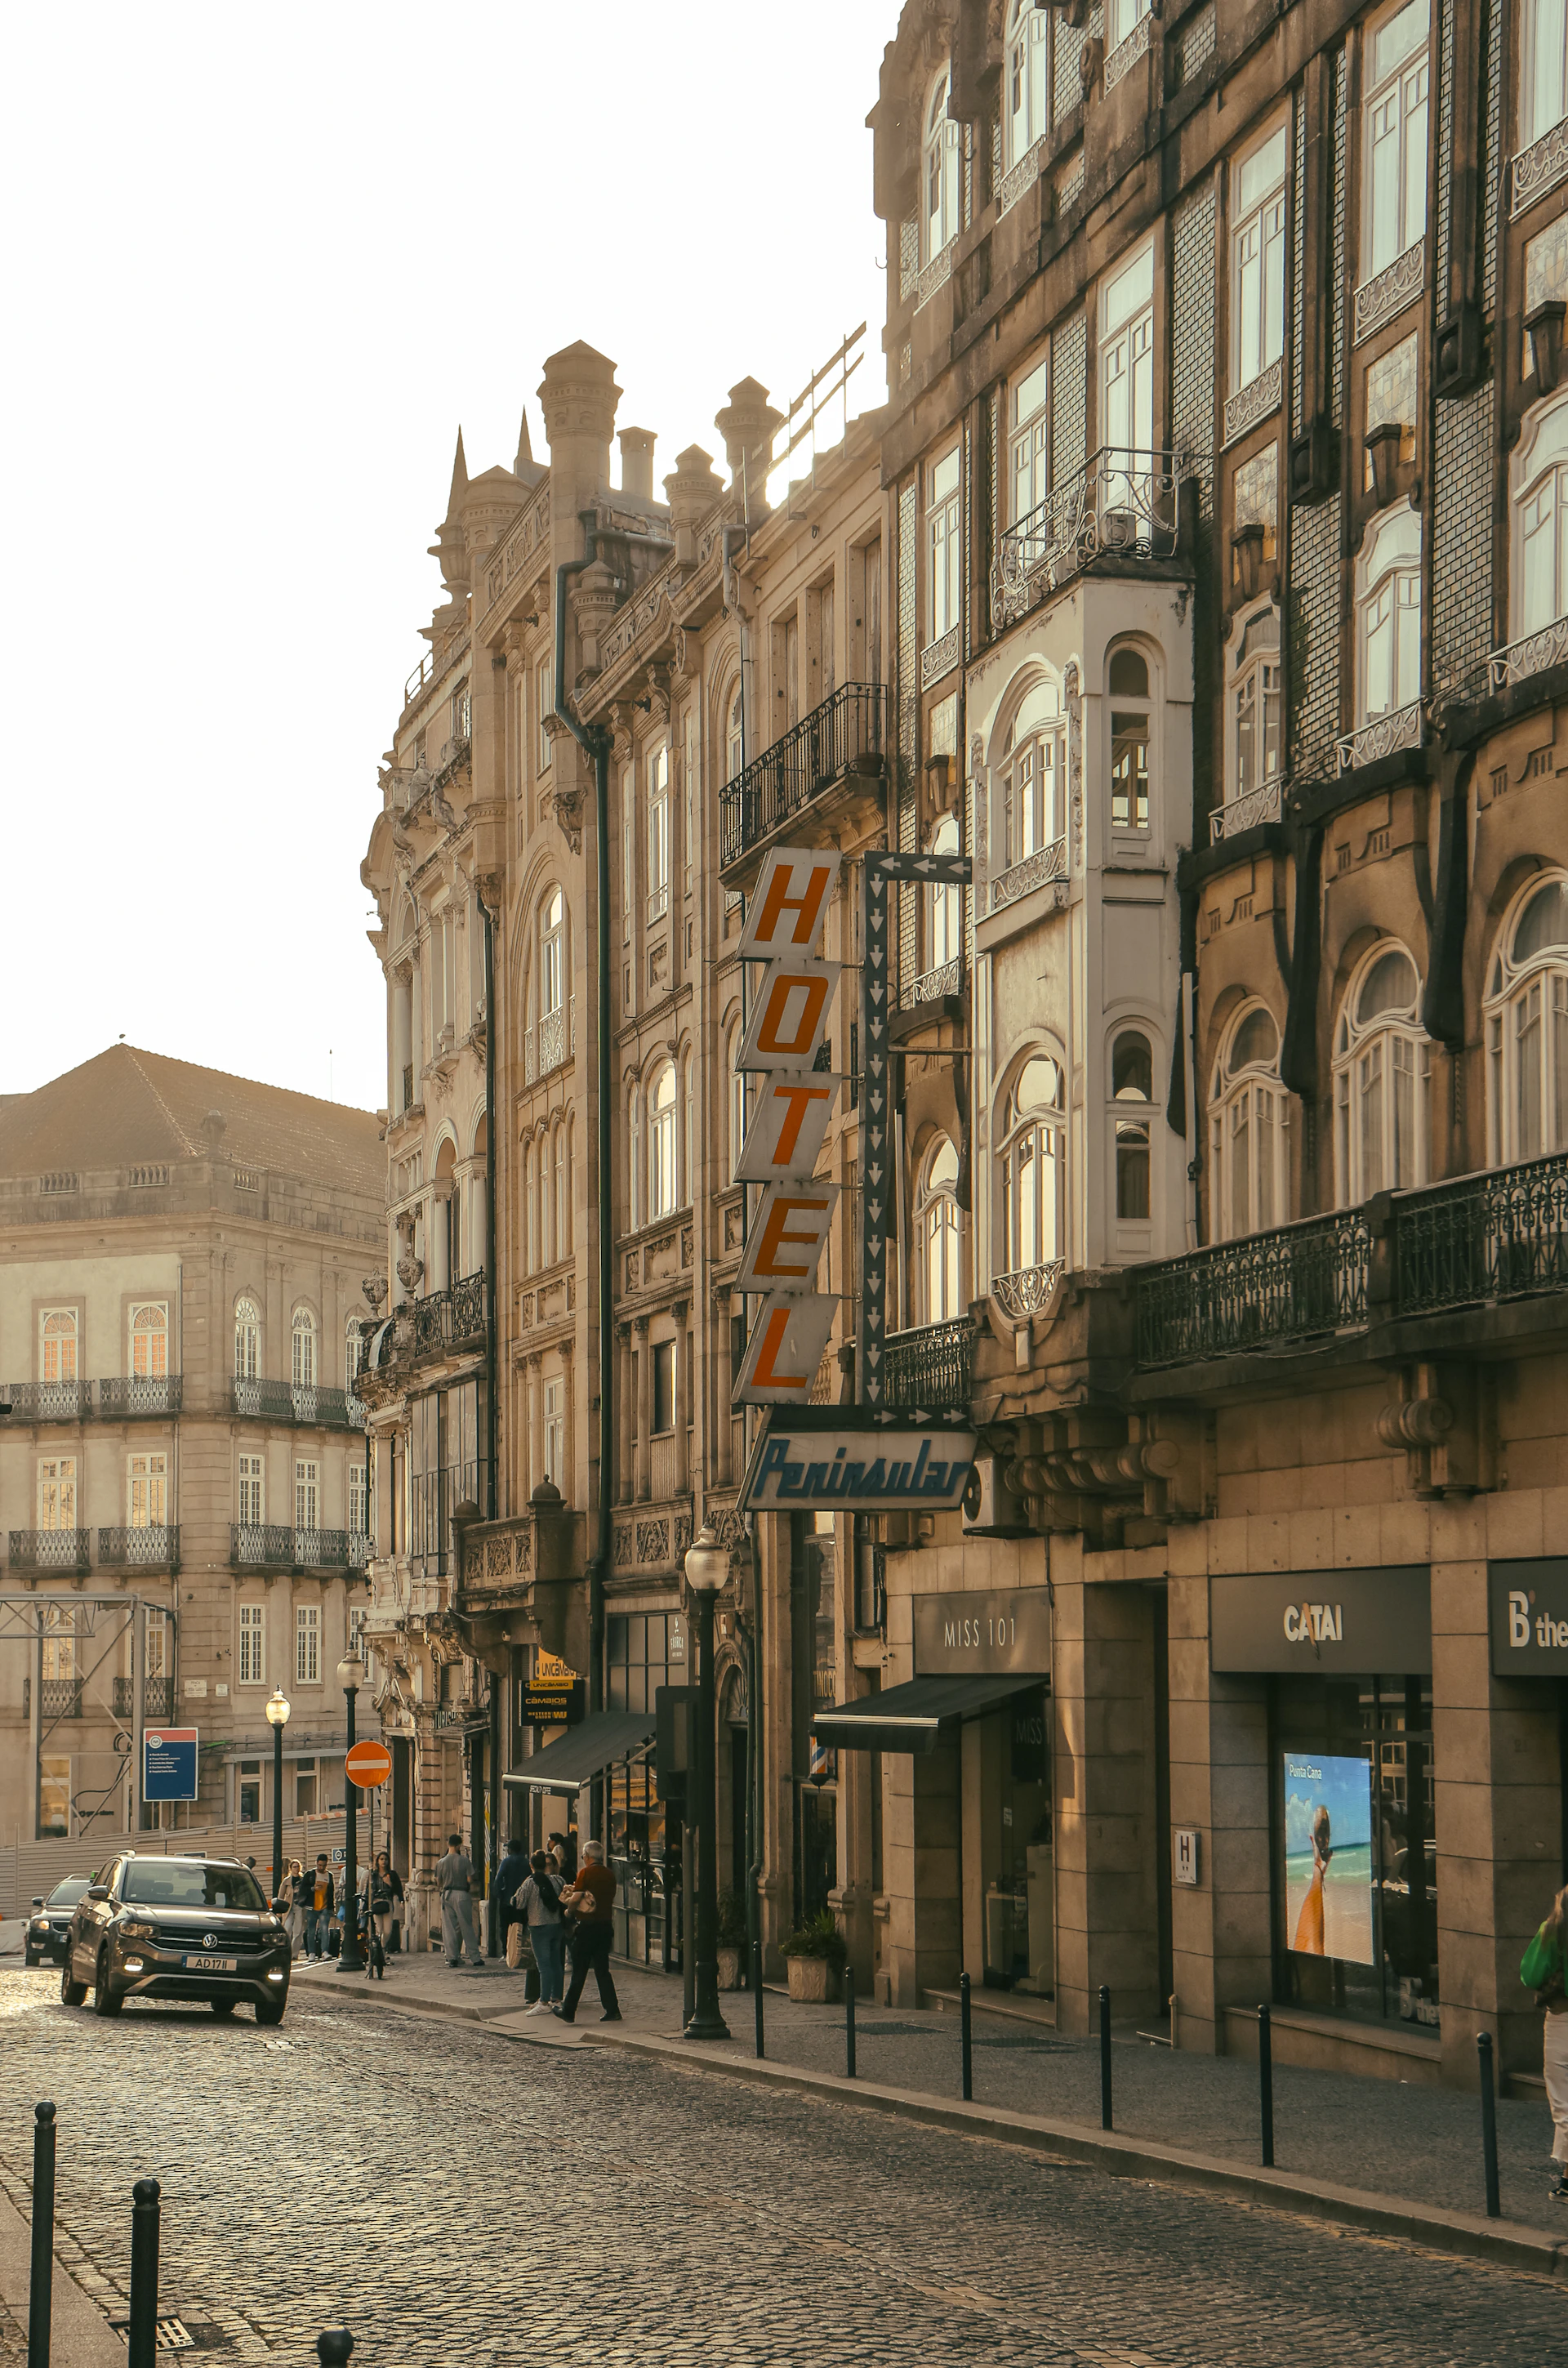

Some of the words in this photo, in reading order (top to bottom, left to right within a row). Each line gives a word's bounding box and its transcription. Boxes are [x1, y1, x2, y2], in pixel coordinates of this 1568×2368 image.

[751, 864, 831, 1389] HOTEL
[752, 1438, 972, 1498] Peninsular
[944, 1619, 980, 1648] MISS
[989, 1617, 1014, 1647] 101
[1284, 1603, 1343, 1643] CATAI
[1535, 1612, 1568, 1648] the
[525, 1697, 568, 1705] CÂMBIOS
[1289, 1764, 1307, 1778] Punta
[1307, 1765, 1322, 1780] Cana
[1180, 1835, 1190, 1862] H
